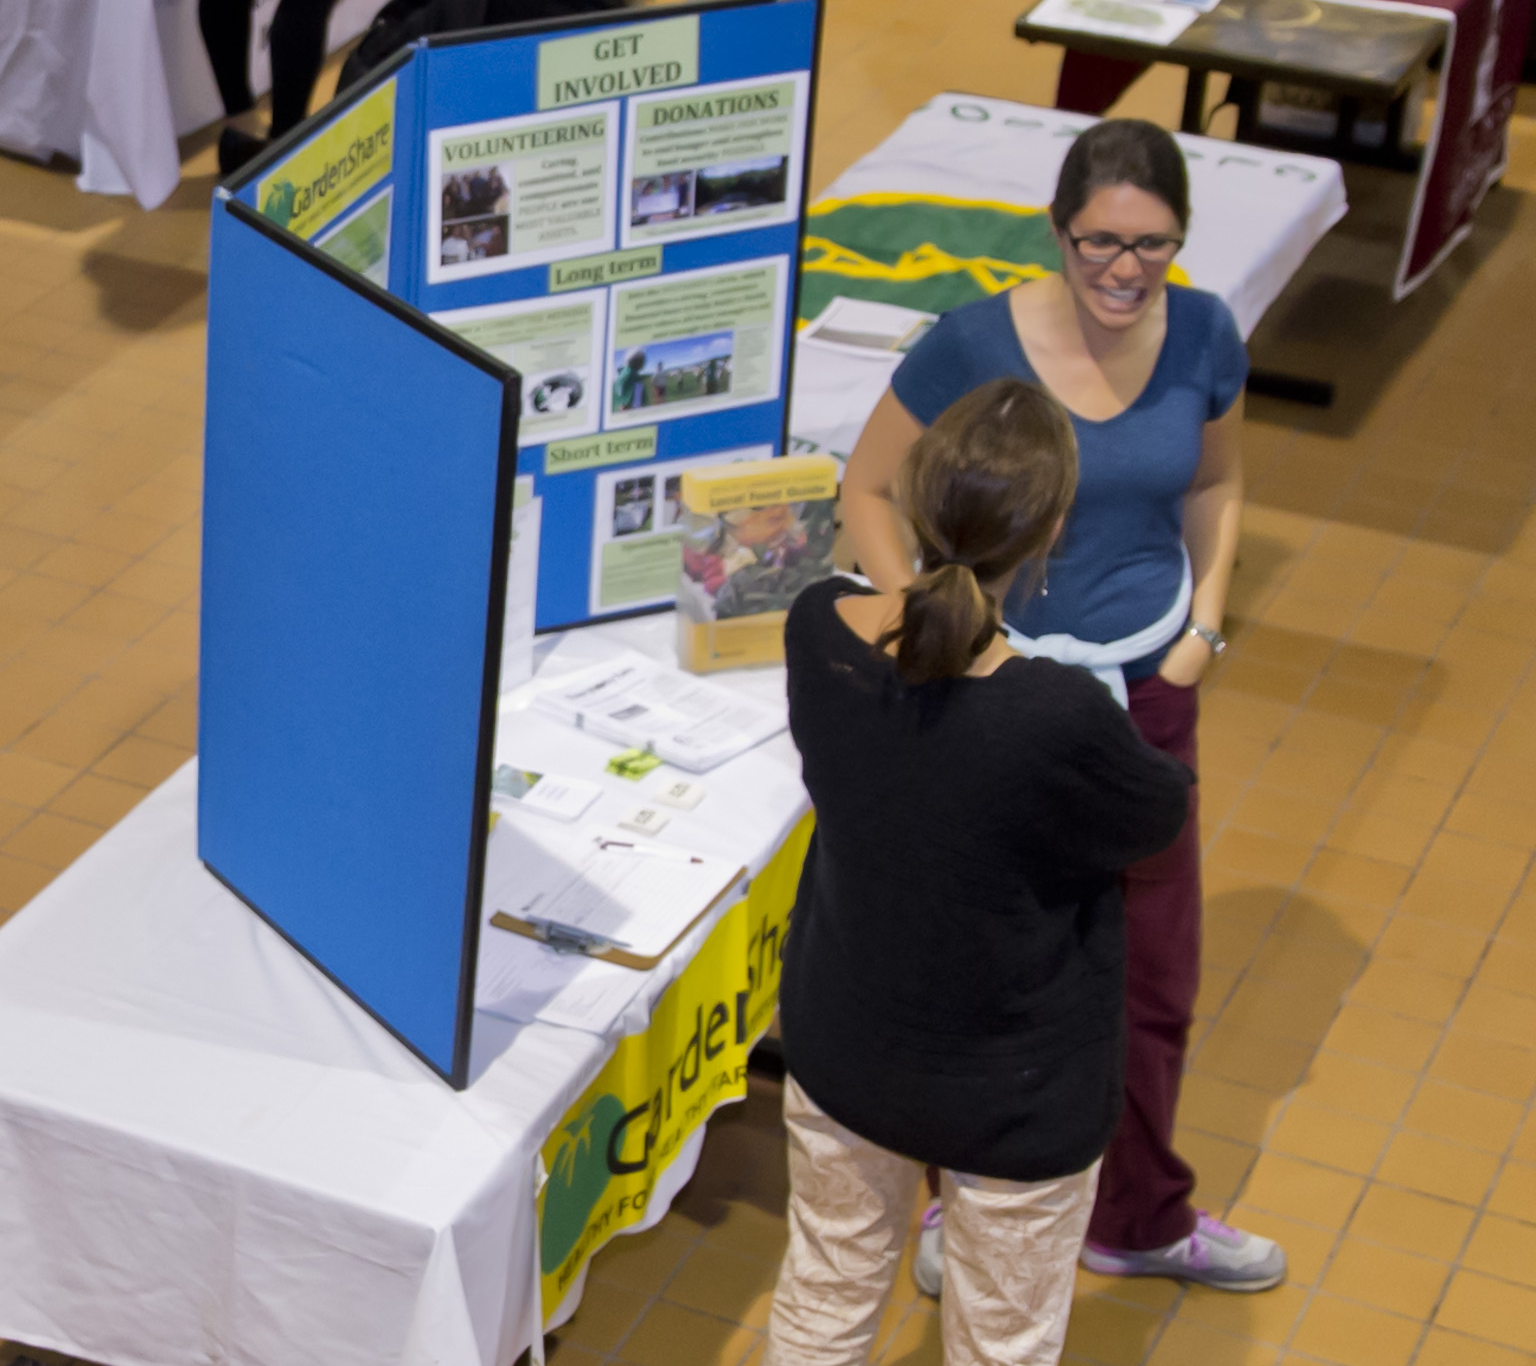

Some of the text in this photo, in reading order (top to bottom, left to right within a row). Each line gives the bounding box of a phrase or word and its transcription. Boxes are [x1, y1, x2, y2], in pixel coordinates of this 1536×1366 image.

[594, 33, 644, 62] GET
[553, 60, 683, 104] INVOLVED
[652, 90, 780, 127] DONATIONS
[442, 120, 606, 163] VOLUNTEERING
[290, 121, 391, 220] GardenShare
[555, 254, 658, 289] Long term
[549, 433, 656, 466] Short term
